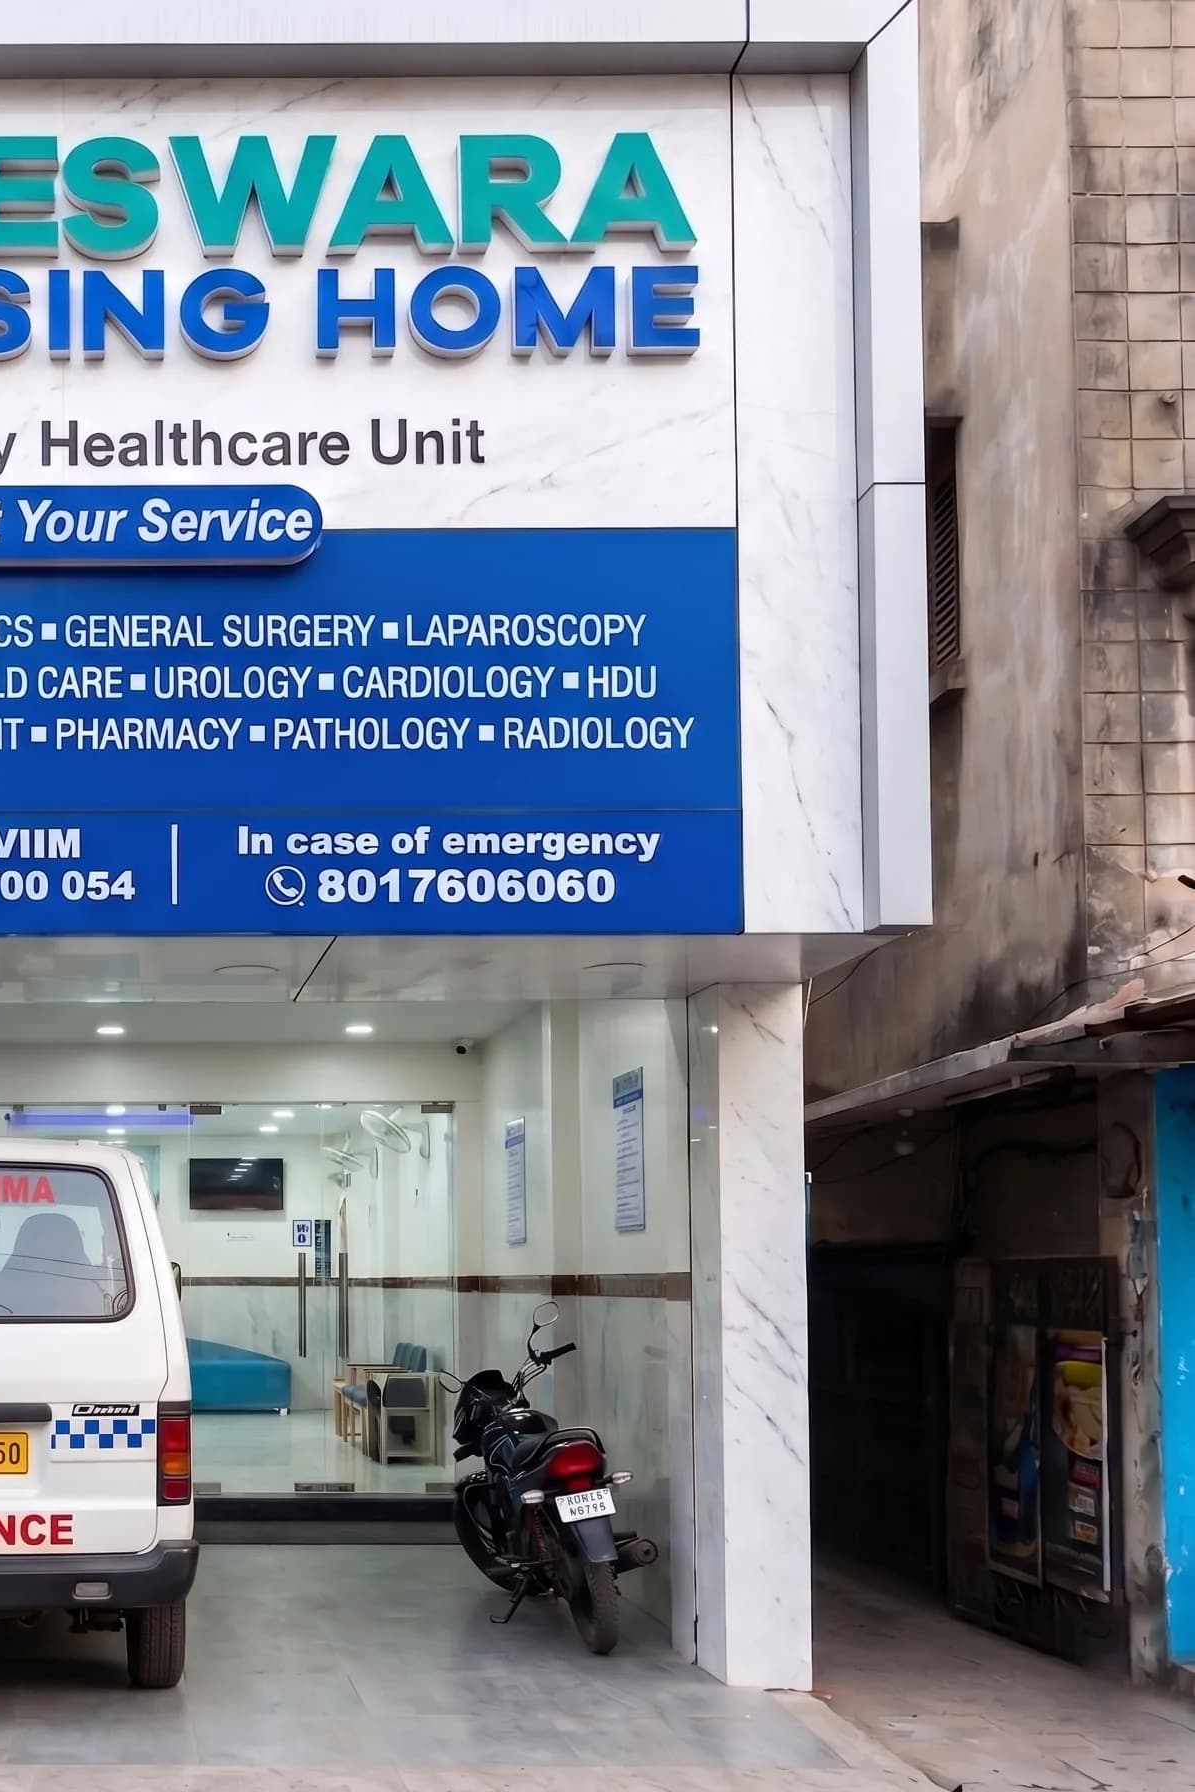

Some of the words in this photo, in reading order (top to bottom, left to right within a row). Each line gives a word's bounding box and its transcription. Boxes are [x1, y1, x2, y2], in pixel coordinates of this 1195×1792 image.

[316, 264, 702, 360] HOME
[41, 419, 349, 466] Healthcare
[371, 418, 485, 465] Unit
[18, 499, 128, 542] Your
[138, 498, 314, 543] Service
[65, 615, 214, 647] GENERAL
[222, 615, 376, 647] SURGERY
[406, 614, 646, 646] LAPAROSCOPY
[38, 667, 123, 699] CARE
[154, 666, 312, 698] UROLOGY
[343, 666, 555, 698] CARDIOLOGY
[588, 666, 656, 698] HDU
[56, 718, 243, 750] PHARMACY
[274, 718, 471, 749] PATHOLOGY
[504, 717, 695, 749] RADIOLOGY
[238, 826, 273, 855] In
[286, 833, 379, 855] case
[391, 826, 431, 855] of
[442, 832, 661, 862] emergency
[62, 870, 136, 900] 054
[317, 868, 616, 903] 8017606060
